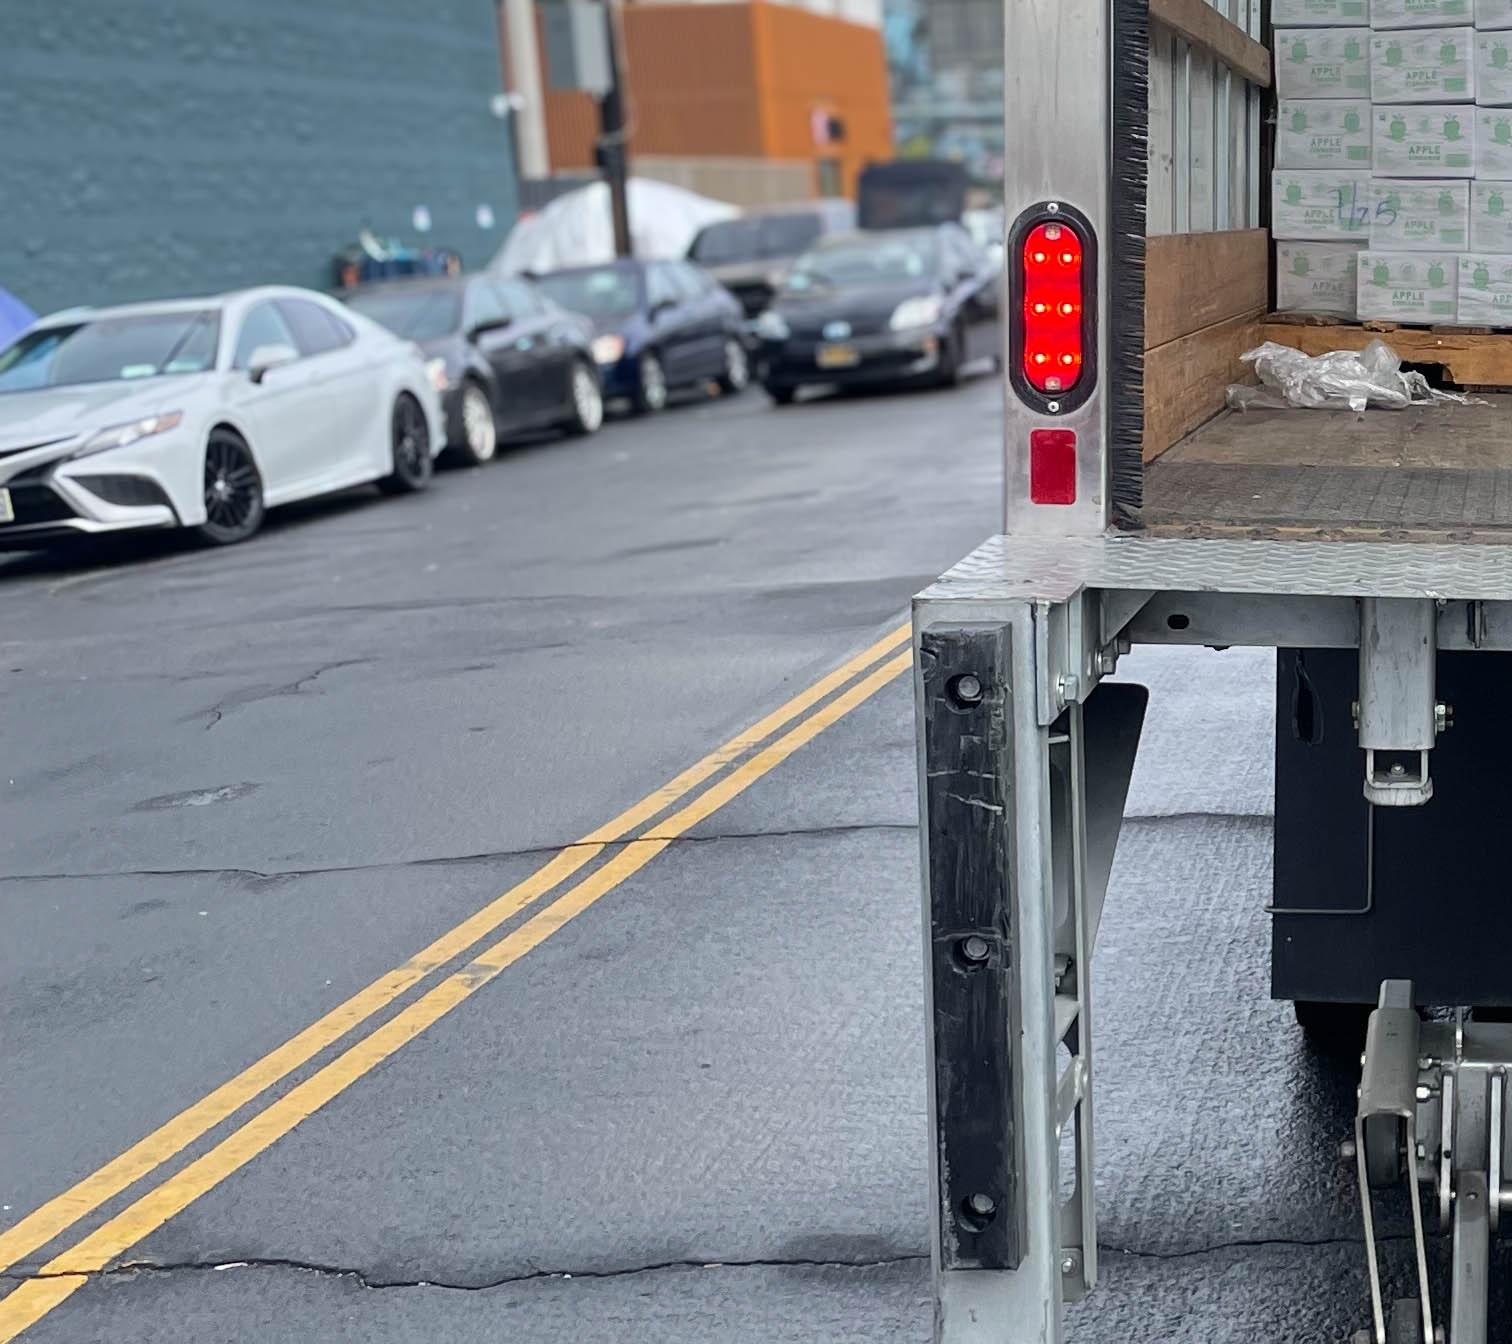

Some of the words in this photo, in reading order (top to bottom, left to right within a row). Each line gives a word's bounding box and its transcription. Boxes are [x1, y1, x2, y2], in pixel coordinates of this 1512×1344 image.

[1311, 67, 1341, 76] APPLE
[1406, 71, 1438, 80] APPLE
[1311, 138, 1342, 146] APPLE
[1409, 145, 1441, 154] APPLE
[1304, 209, 1335, 217] APPLE
[1392, 291, 1425, 300] APPLE
